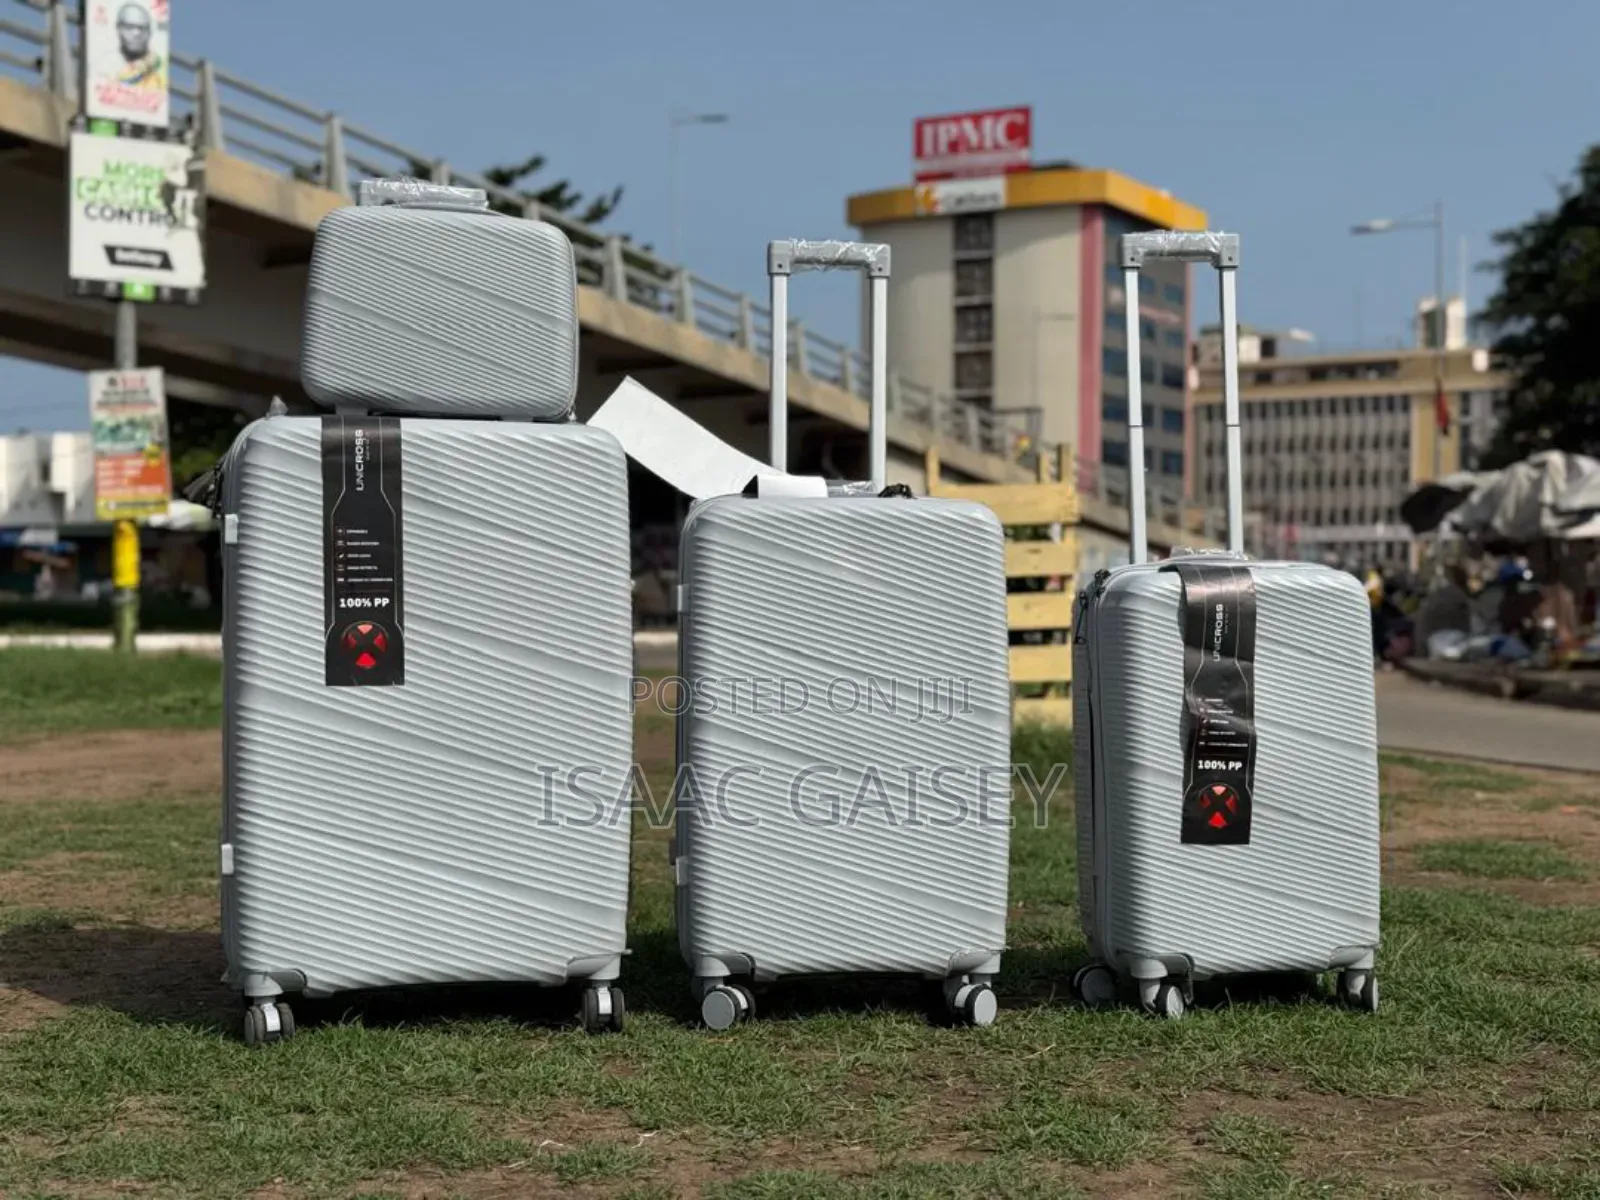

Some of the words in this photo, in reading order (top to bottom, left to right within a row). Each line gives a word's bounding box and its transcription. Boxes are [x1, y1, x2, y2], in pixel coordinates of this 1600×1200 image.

[921, 111, 1027, 156] IPMC
[355, 429, 364, 491] UNICROSS
[339, 598, 372, 608] 100%
[374, 598, 390, 607] PP
[1213, 603, 1223, 661] UNICROSS
[1198, 760, 1226, 770] 100%
[1228, 761, 1243, 771] PP
